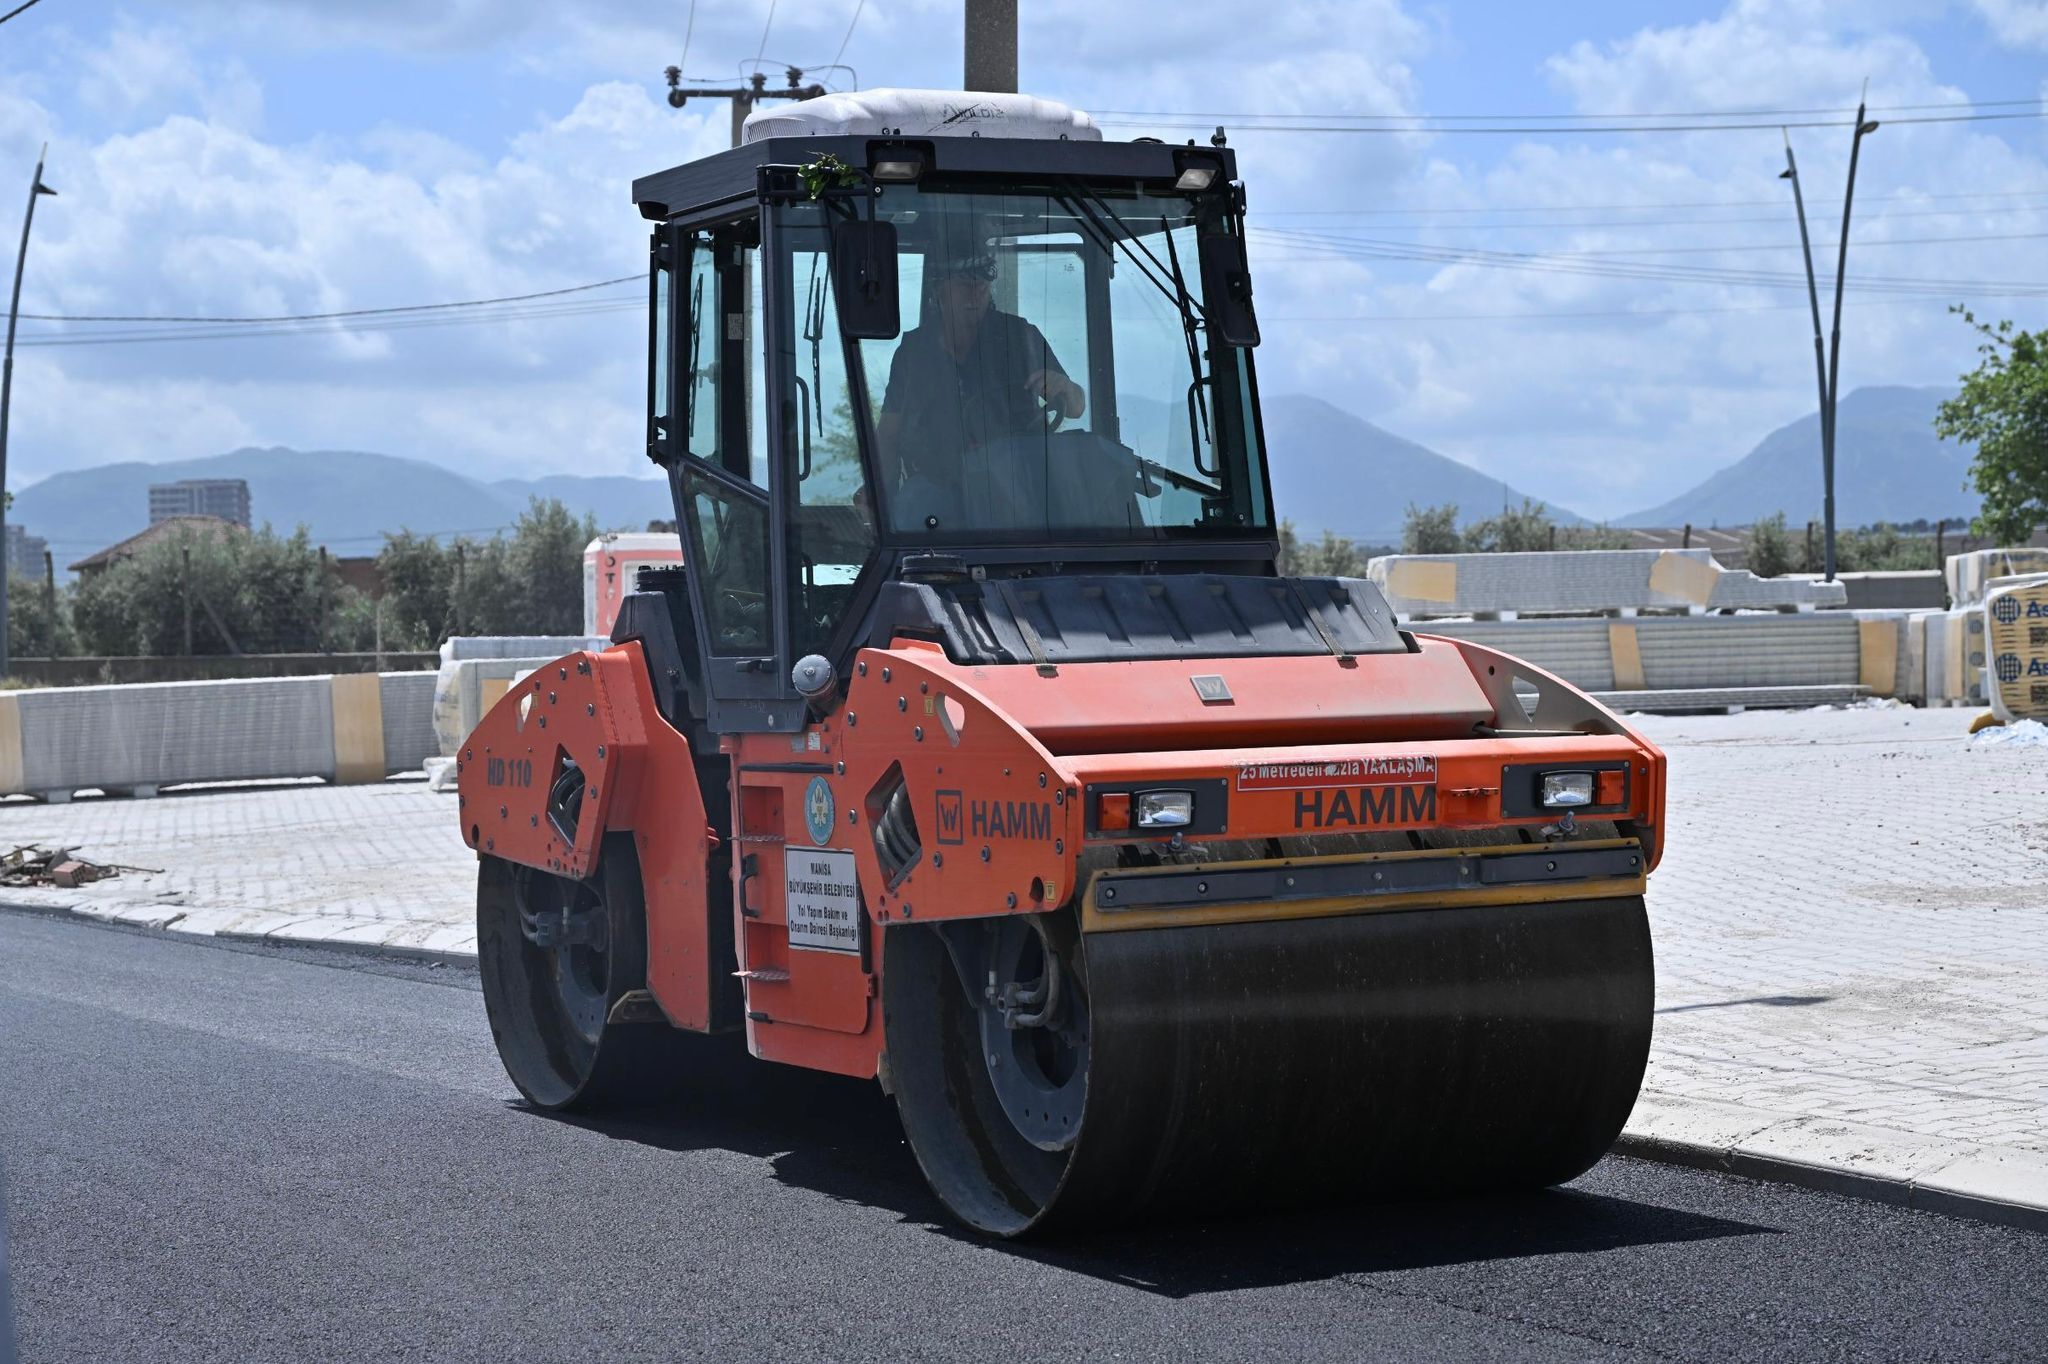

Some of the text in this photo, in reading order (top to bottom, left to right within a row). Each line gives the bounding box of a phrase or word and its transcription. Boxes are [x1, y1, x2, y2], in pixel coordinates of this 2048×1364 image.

[487, 757, 532, 788] HD 110
[1361, 756, 1435, 778] YAKLAŞMA
[1295, 785, 1435, 828] HAMM
[971, 800, 1052, 840] HAMM
[810, 861, 832, 876] MANİSA
[789, 879, 856, 898] BÜYÜKŞEHİR BELEDİYESİ
[797, 904, 848, 921] Yol Yapım Bakım ve
[809, 921, 828, 935] Dairesi
[829, 923, 856, 941] Başkanlığı
